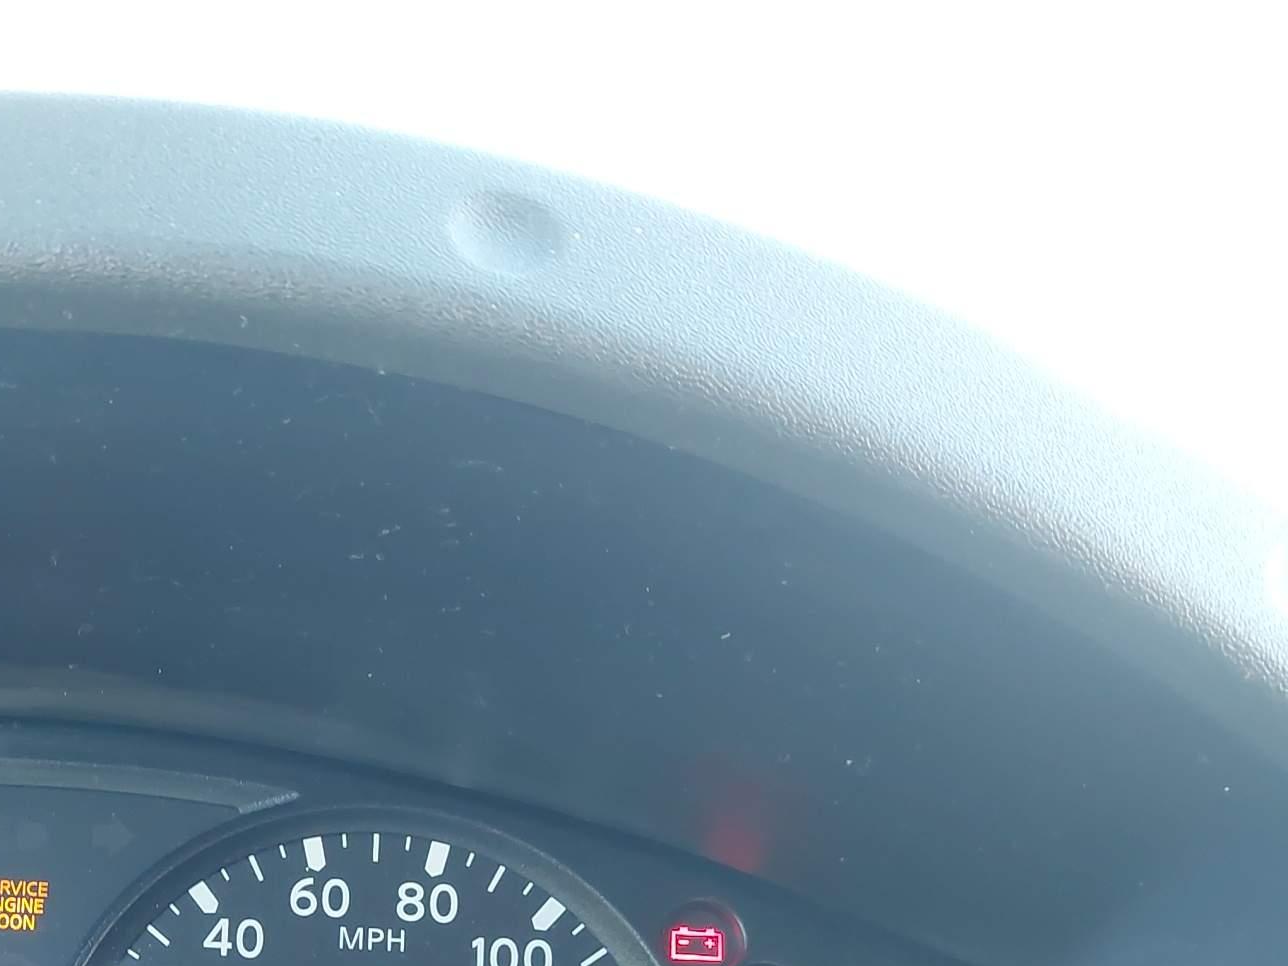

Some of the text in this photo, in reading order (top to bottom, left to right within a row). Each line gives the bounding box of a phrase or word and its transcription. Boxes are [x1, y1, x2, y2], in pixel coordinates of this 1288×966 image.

[289, 877, 351, 918] 60
[395, 882, 459, 924] 80
[203, 918, 265, 959] 40
[338, 925, 406, 953] MPH
